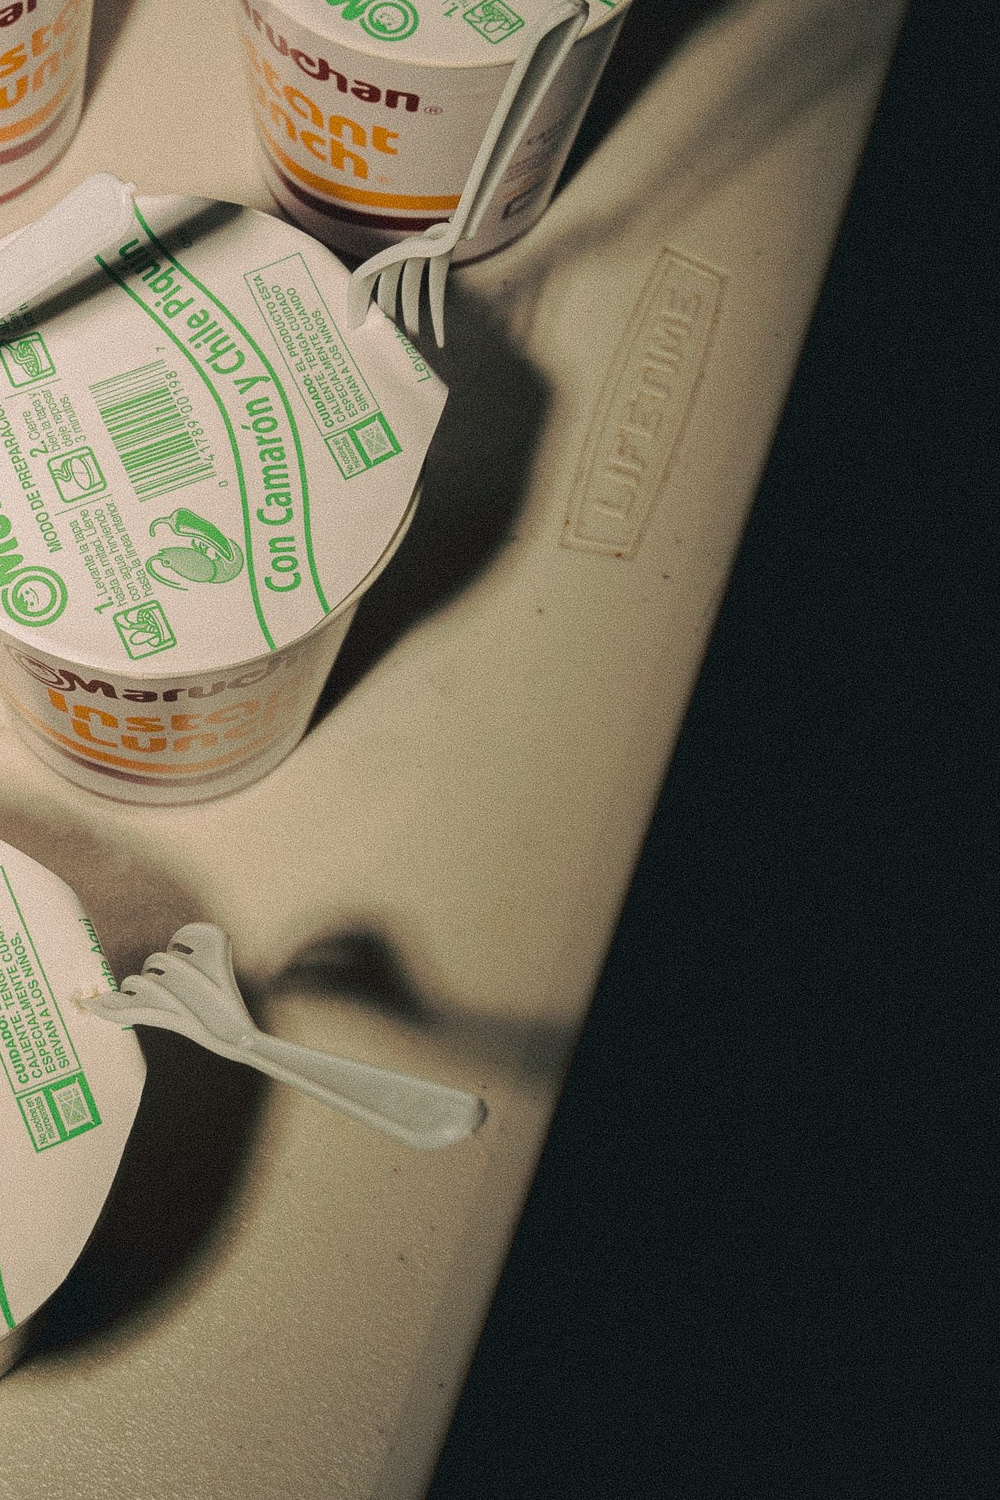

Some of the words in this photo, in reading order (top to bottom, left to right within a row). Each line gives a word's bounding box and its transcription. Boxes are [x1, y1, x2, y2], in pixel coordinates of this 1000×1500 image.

[186, 309, 246, 376] Chile
[232, 374, 273, 395] y
[595, 290, 704, 519] LIFETIME
[241, 395, 294, 525] Camarón
[24, 489, 46, 511] DE
[33, 510, 64, 554] MODO
[262, 533, 302, 593] Con
[9, 931, 35, 978] NIÑOS.
[26, 977, 46, 1007] LOS
[38, 1006, 52, 1018] A
[6, 966, 56, 1073] ESPECIALMENTE
[42, 1019, 70, 1069] SIRVAN
[9, 1012, 43, 1079] CALIENTE.
